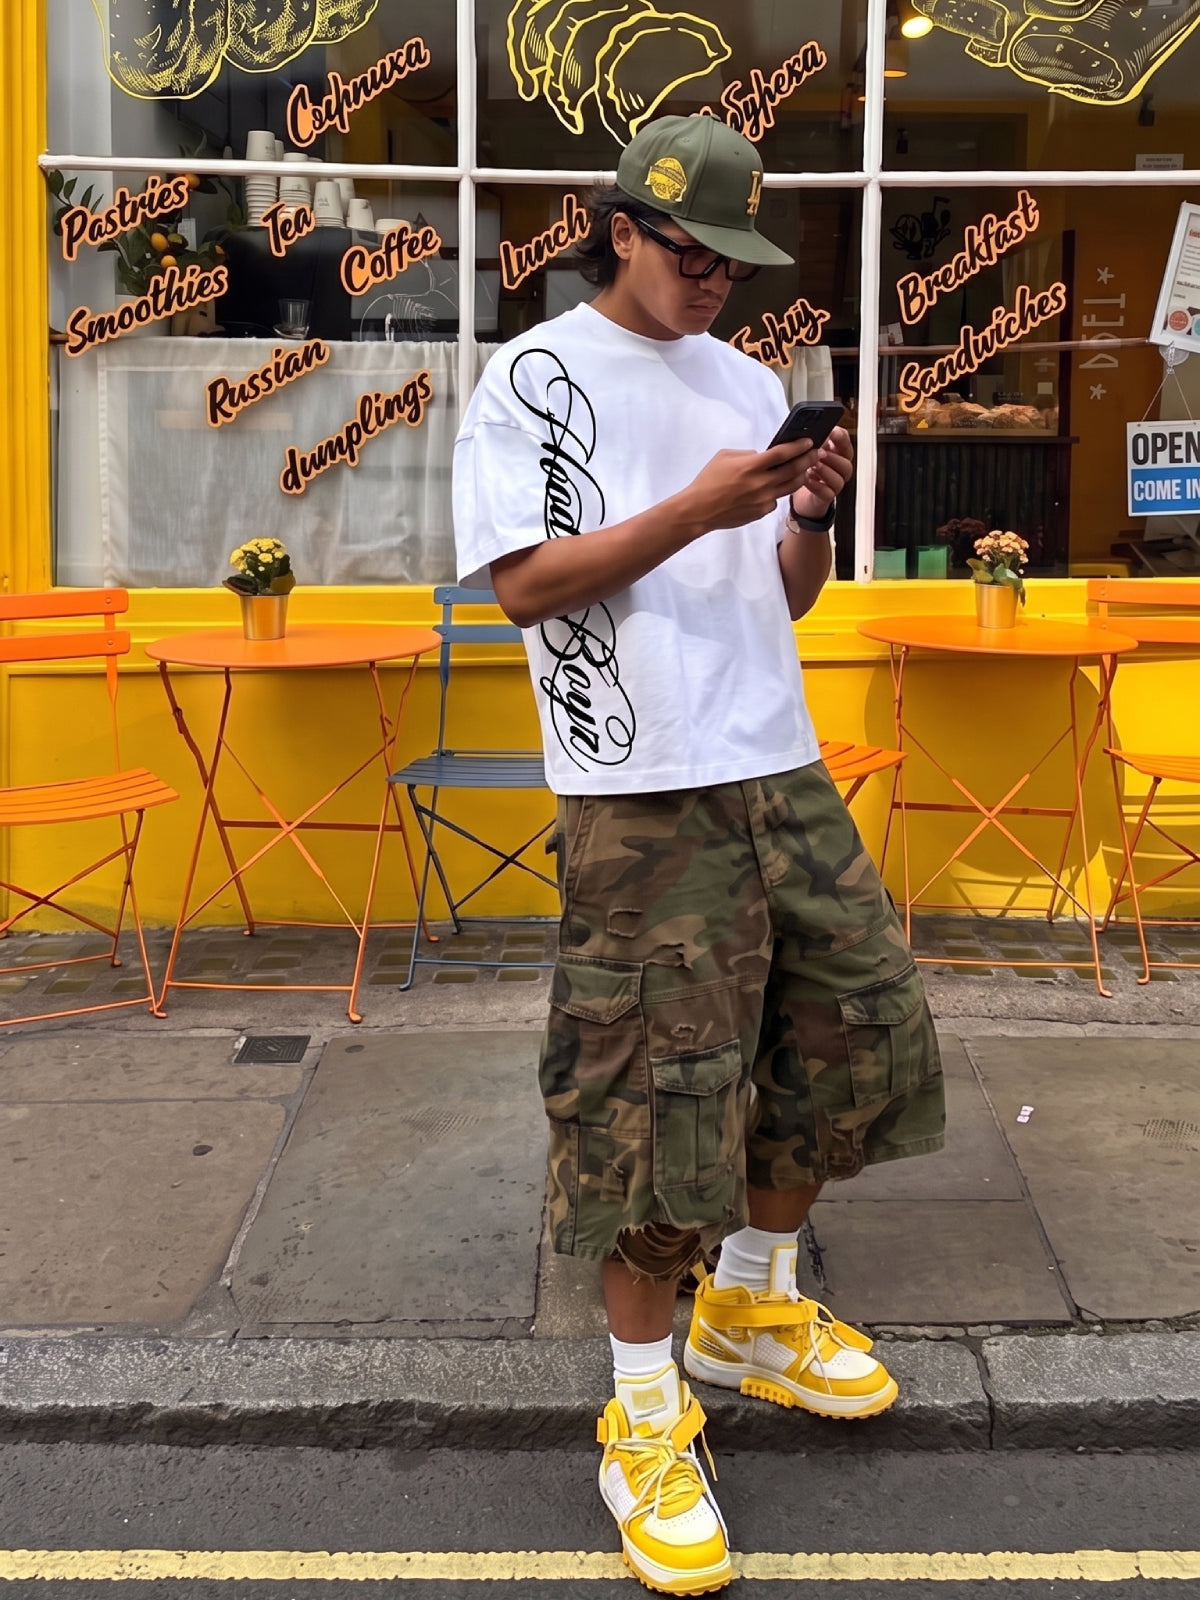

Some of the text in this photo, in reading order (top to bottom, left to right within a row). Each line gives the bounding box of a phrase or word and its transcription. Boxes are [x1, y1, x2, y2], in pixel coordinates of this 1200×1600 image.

[63, 178, 188, 259] Pastries
[262, 202, 313, 254] Tea
[342, 224, 440, 294] Coffee
[501, 195, 589, 287] Lunch
[898, 191, 1038, 322] Breakfast
[67, 266, 226, 355] Smoothies
[901, 284, 1065, 410] Sandwiches
[207, 340, 327, 426] Russian
[281, 371, 431, 492] dumplings
[1132, 431, 1200, 465] OPEN
[1133, 479, 1182, 501] COME
